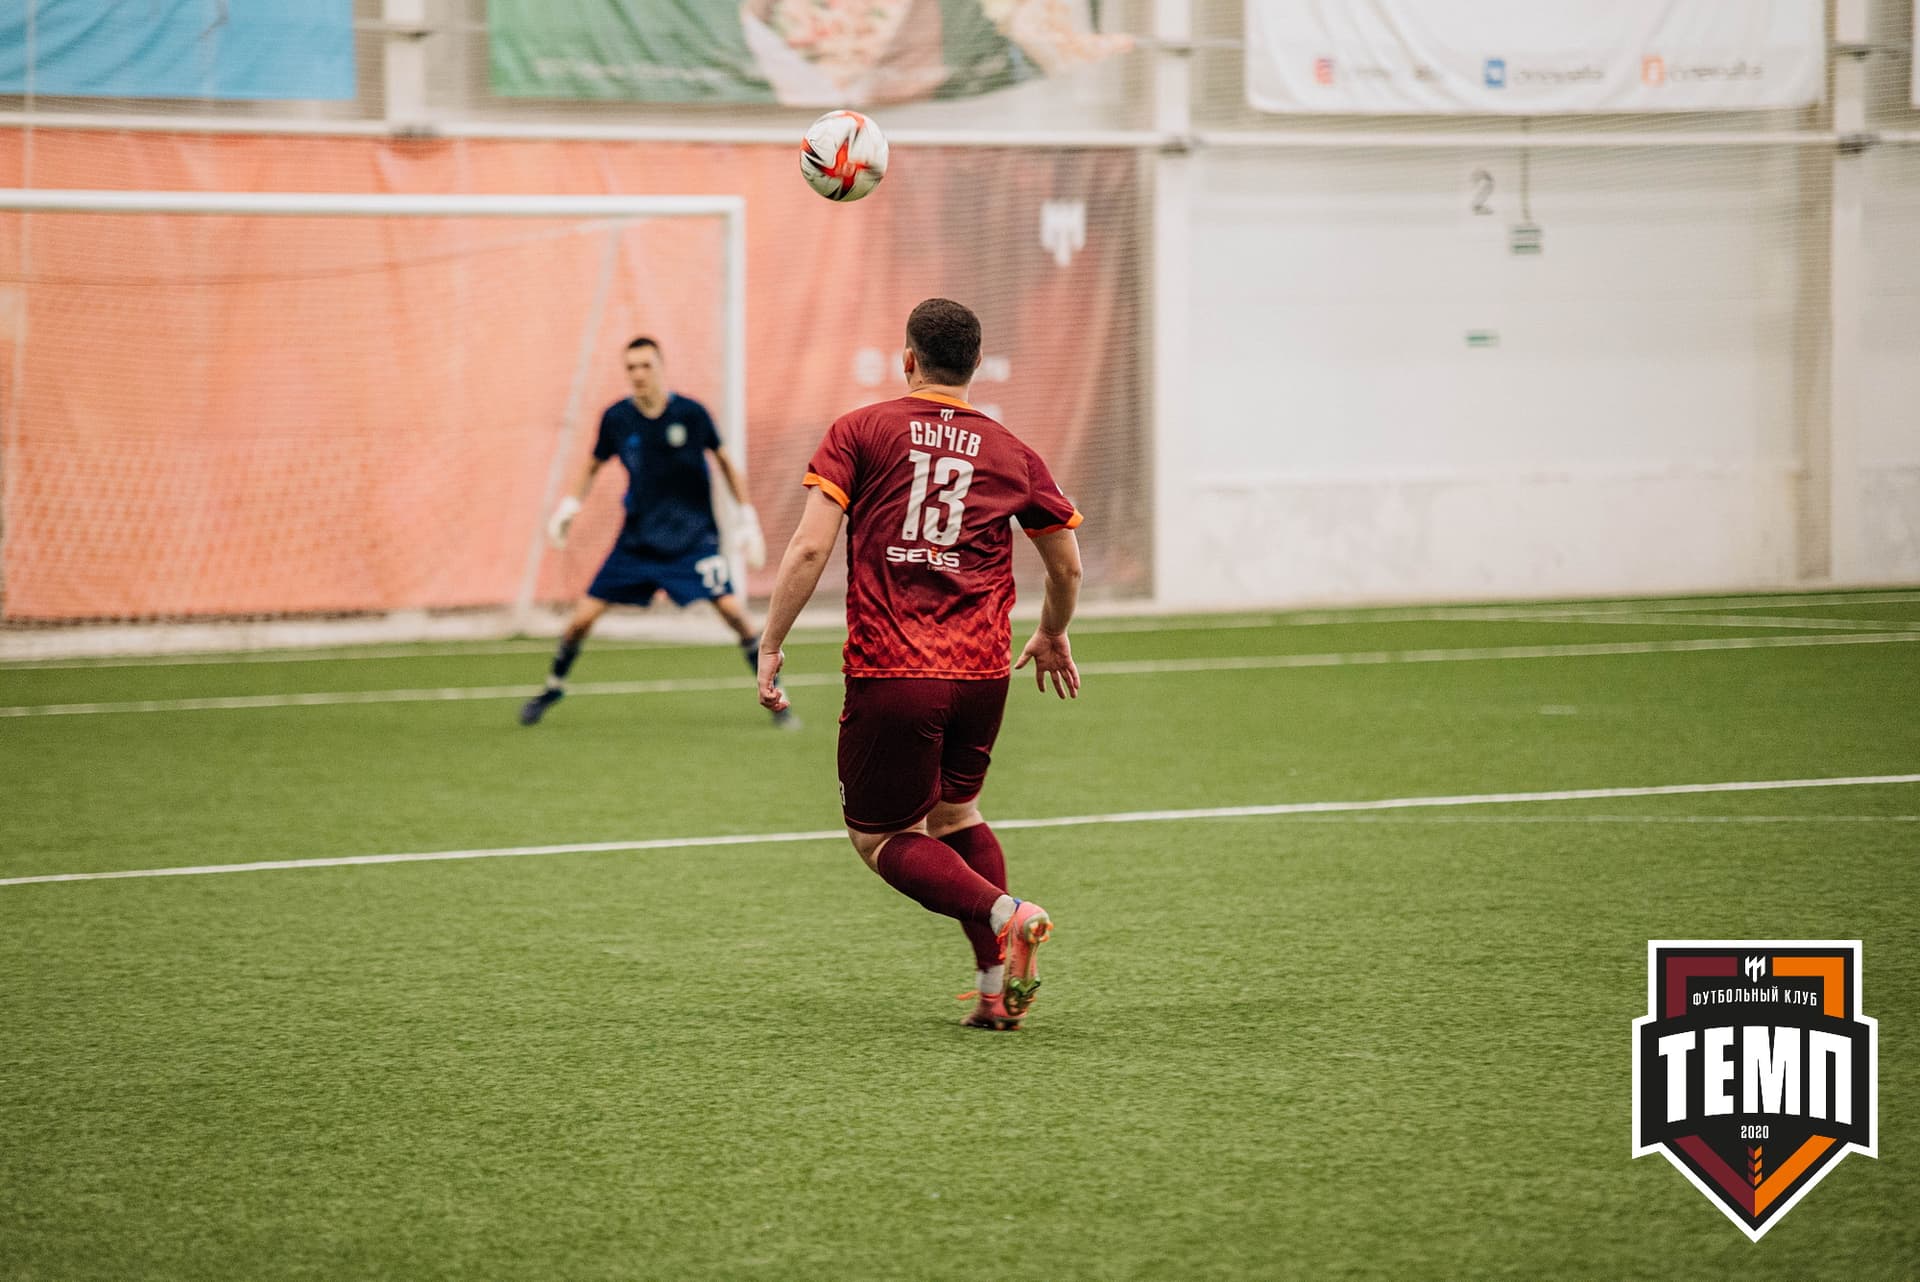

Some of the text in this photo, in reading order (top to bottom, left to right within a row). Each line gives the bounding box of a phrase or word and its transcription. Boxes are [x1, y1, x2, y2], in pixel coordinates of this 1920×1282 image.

[1471, 170, 1494, 215] 2
[909, 420, 982, 457] СЫЧЕВ
[901, 450, 975, 546] 13
